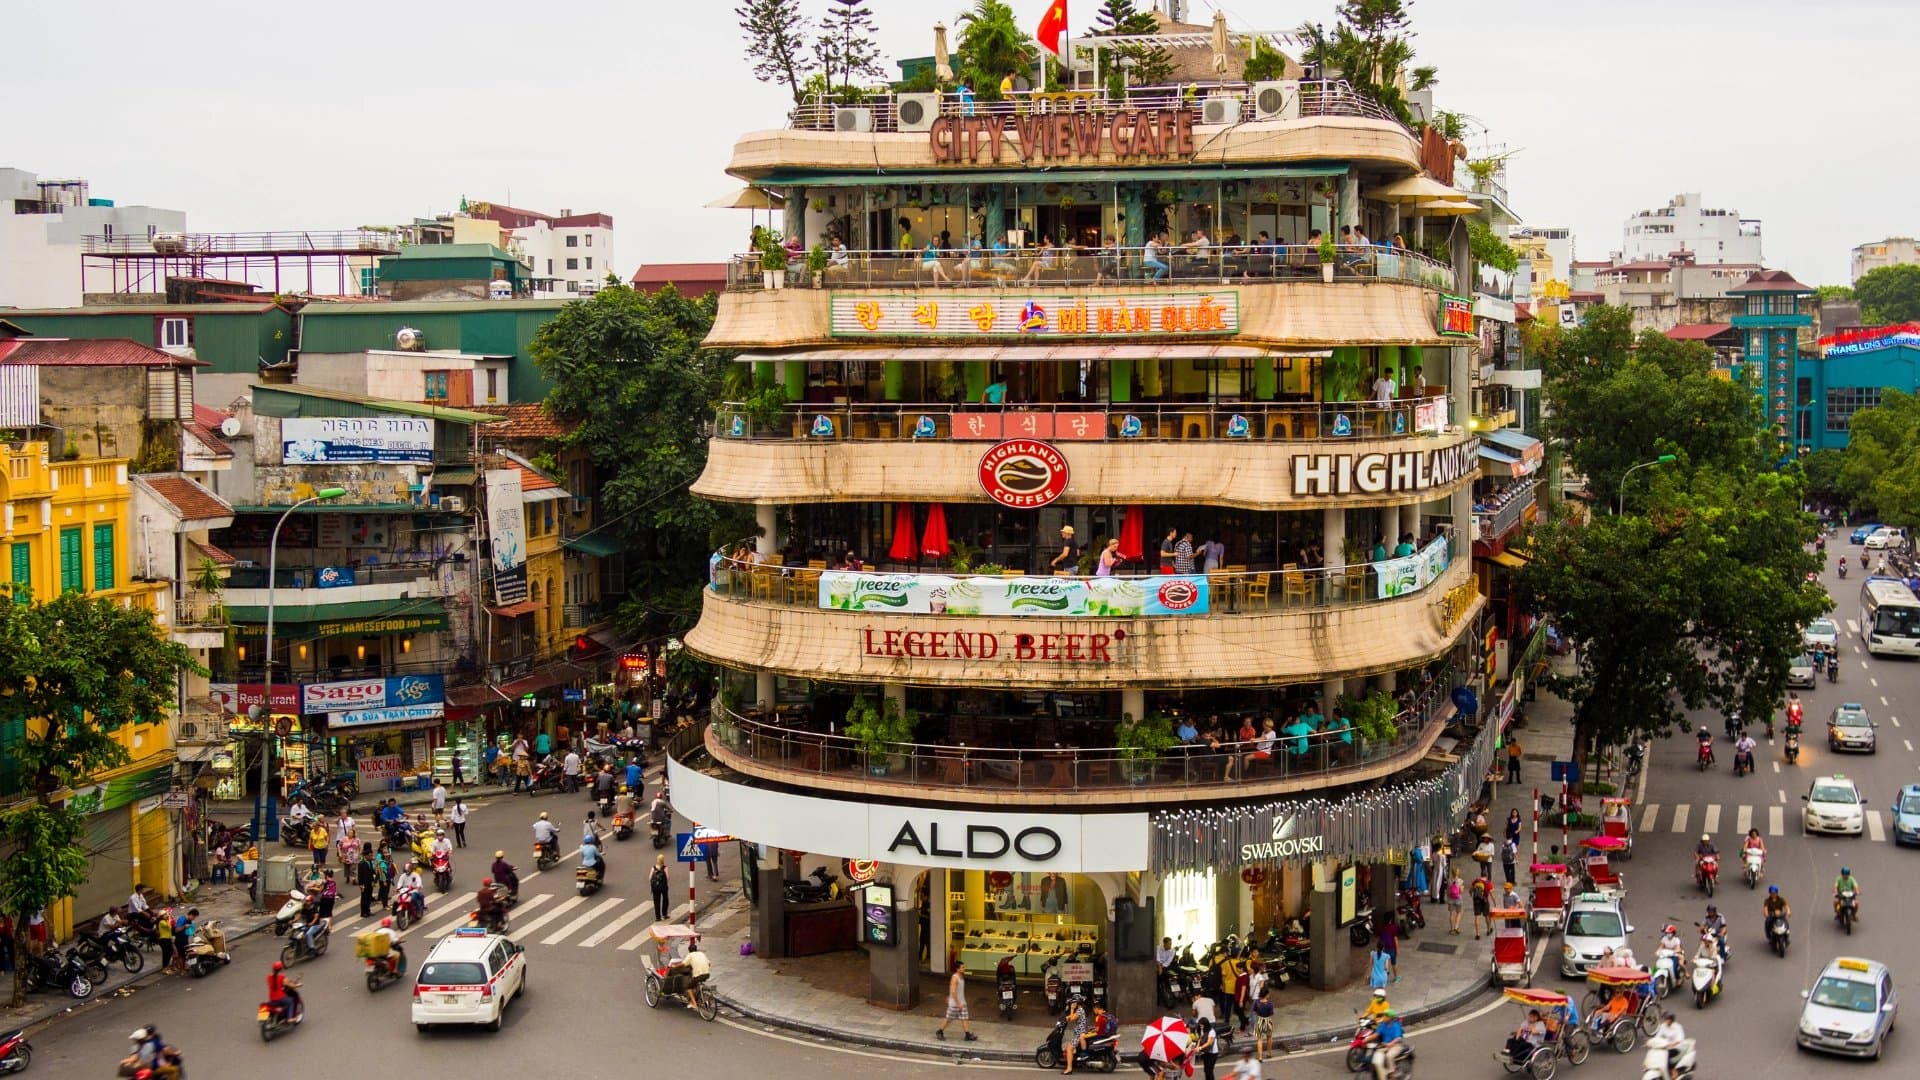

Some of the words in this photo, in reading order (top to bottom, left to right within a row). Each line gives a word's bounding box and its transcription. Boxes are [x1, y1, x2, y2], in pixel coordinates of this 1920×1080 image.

[930, 115, 1006, 161] CITY
[1015, 111, 1104, 161] VIEW
[1110, 110, 1194, 157] CAFE
[984, 444, 1063, 472] HIGHLANDS
[1291, 446, 1460, 496] HIGHLANDS
[994, 488, 1055, 504] COFFEE
[855, 577, 900, 594] freeze
[1005, 581, 1059, 597] freeze
[1164, 600, 1193, 609] COFFEE
[863, 628, 998, 659] LEGEND
[1014, 633, 1111, 662] BEER
[307, 684, 383, 701] Sago
[888, 819, 1062, 862] ALDO
[1241, 836, 1323, 860] SWAROVSKI
